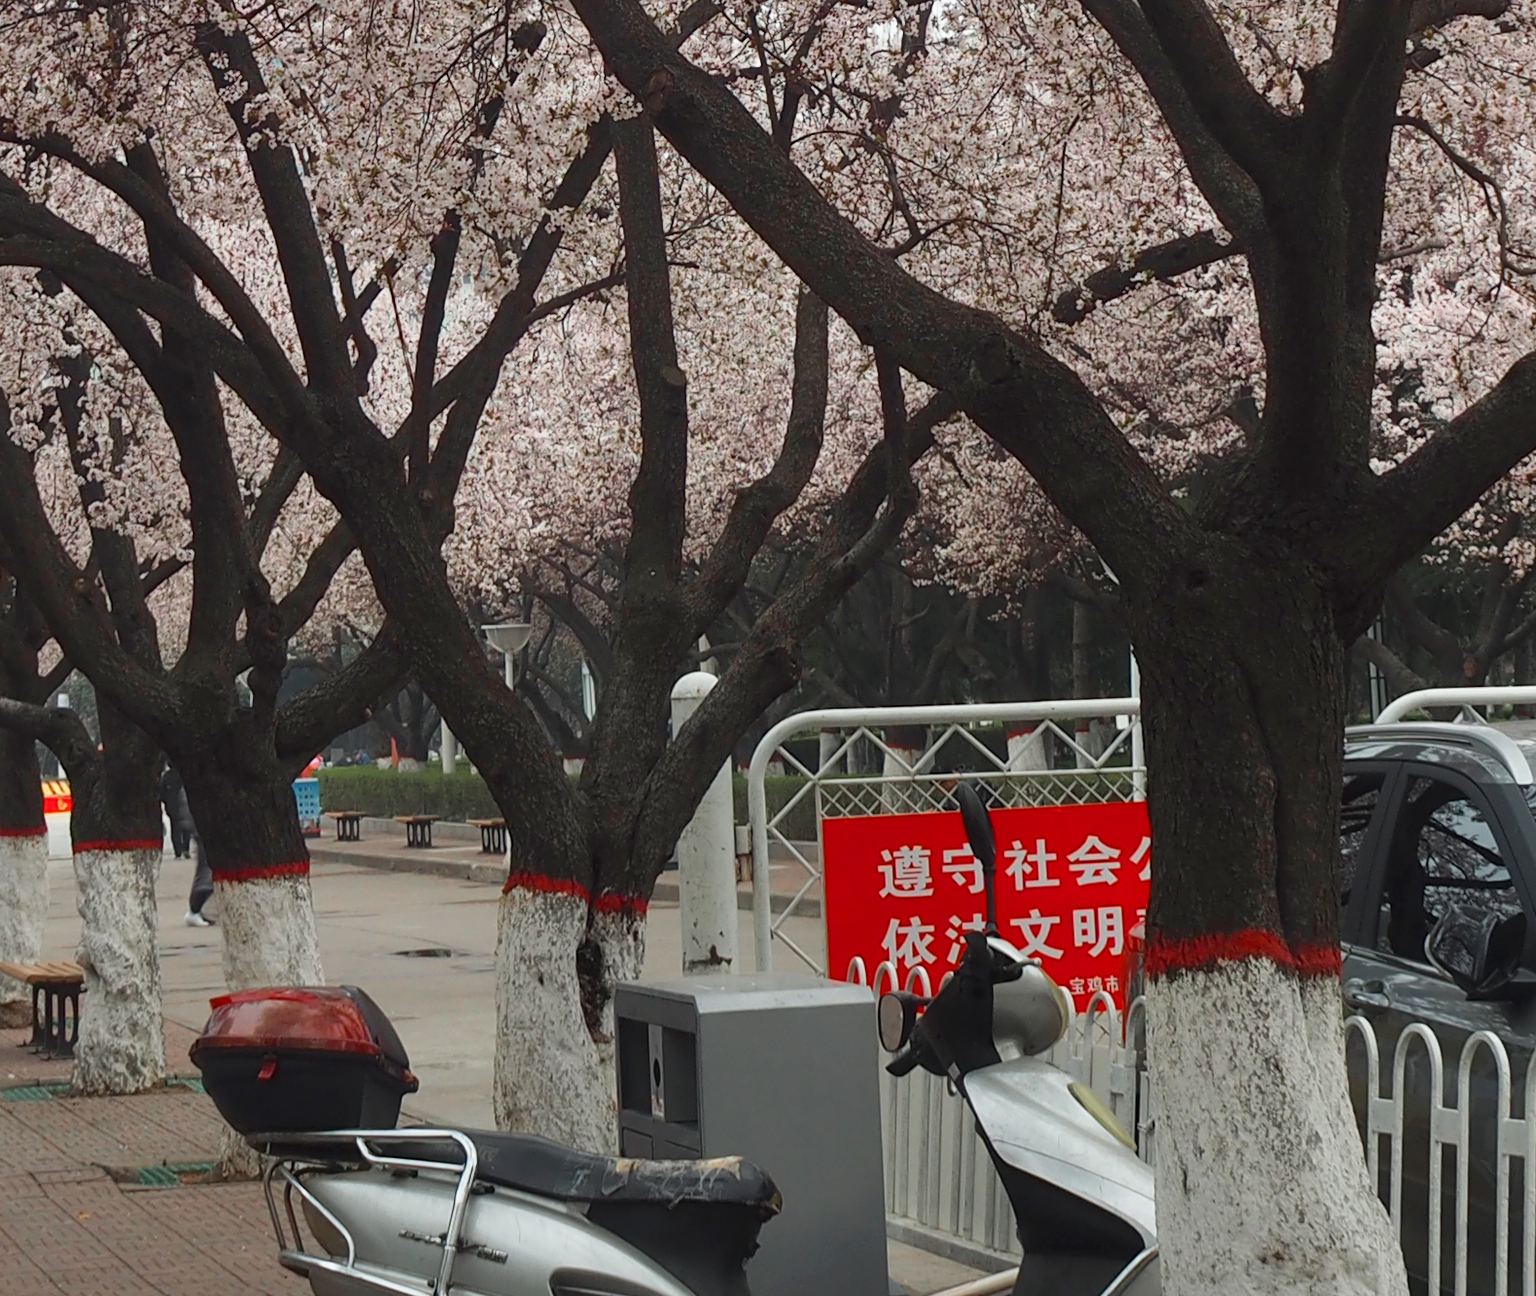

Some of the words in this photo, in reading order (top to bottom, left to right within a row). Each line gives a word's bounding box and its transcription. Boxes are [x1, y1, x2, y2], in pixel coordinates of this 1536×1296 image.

[881, 905, 1147, 970] 依法文明
[1069, 974, 1120, 996] 宝鸡市
